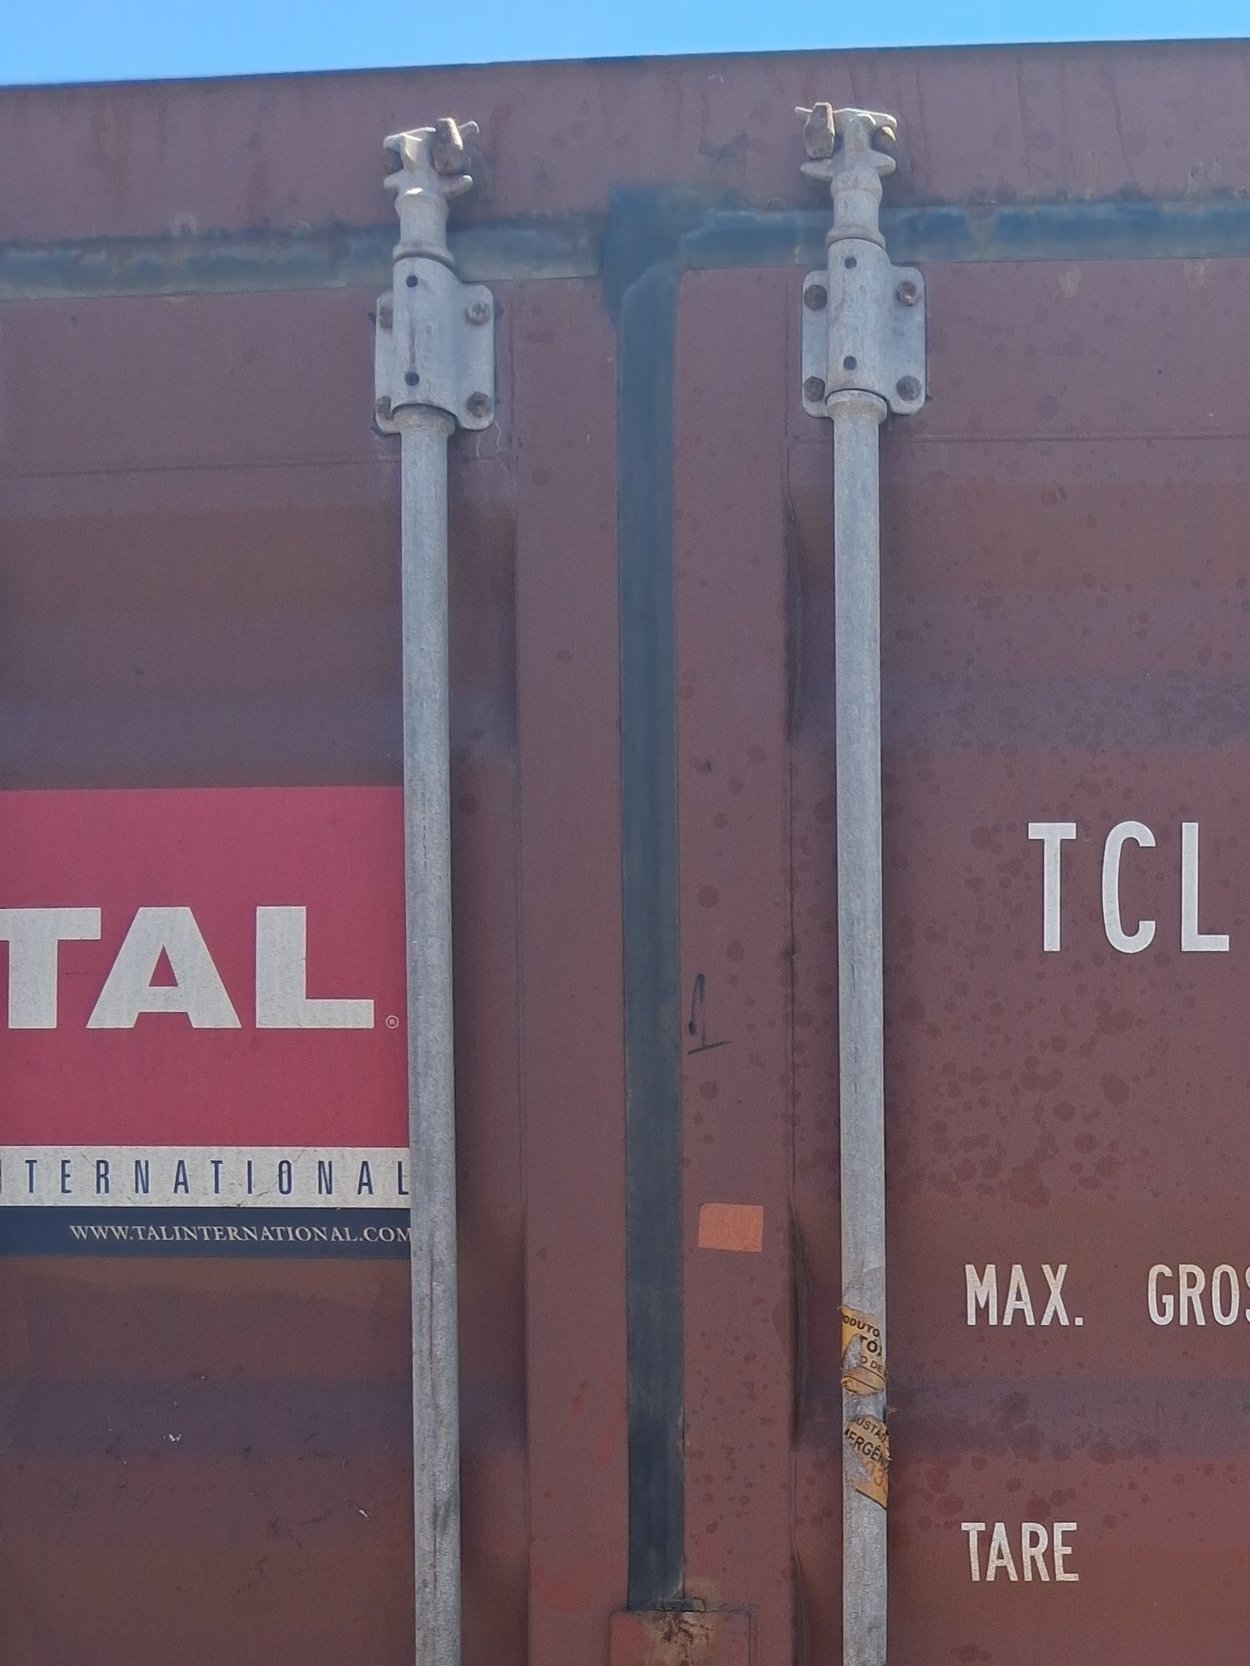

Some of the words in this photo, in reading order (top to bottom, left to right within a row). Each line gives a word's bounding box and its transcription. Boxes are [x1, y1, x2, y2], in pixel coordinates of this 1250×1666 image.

[0, 905, 375, 1029] TAL
[0, 1159, 410, 1196] TERNATIONAL
[69, 1224, 411, 1243] WWW.TALINTERNATIONAL.COM
[965, 1264, 1084, 1326] MAX.
[960, 1522, 1080, 1582] TARE
